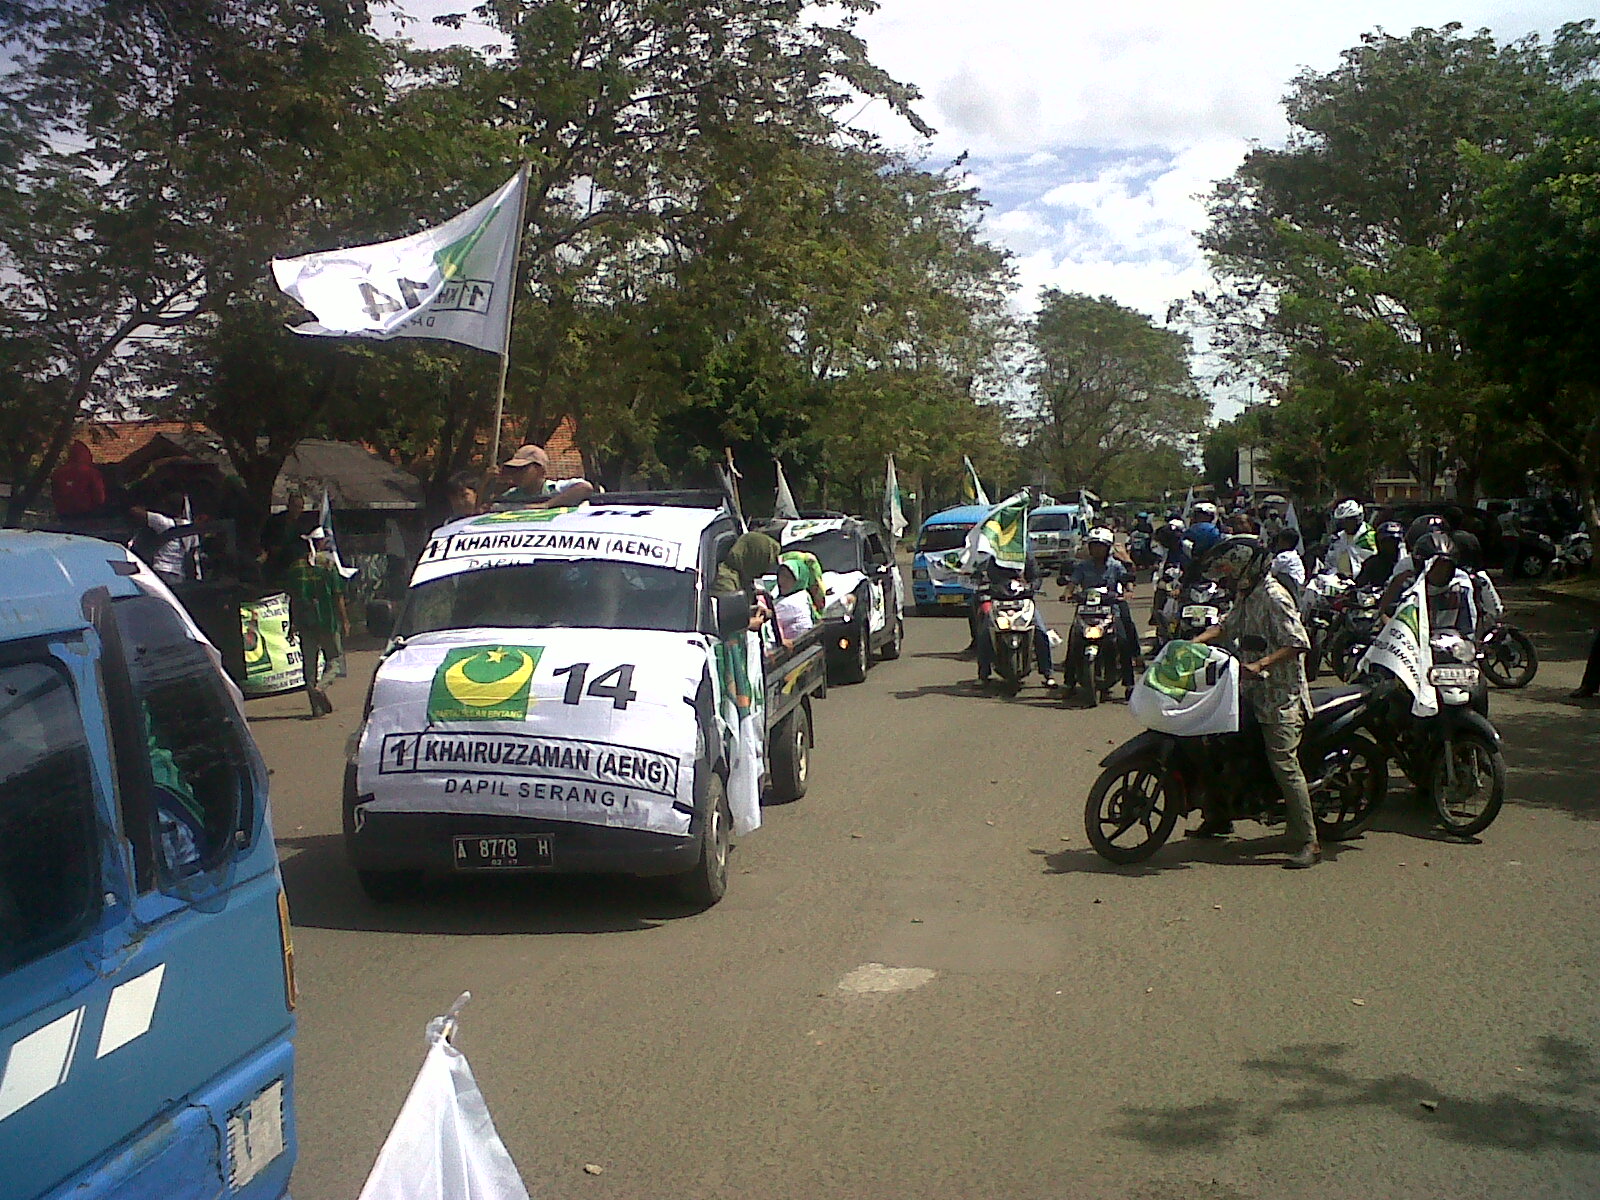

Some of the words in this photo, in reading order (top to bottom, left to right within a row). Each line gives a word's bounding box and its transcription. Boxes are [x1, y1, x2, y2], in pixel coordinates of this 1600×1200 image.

[454, 534, 600, 552] KHAIRUZZAMAN
[605, 537, 671, 563] (AENG)
[552, 663, 637, 710] 14
[425, 741, 590, 771] KHAIRUZZAMAN
[596, 751, 670, 790] (AENG)
[445, 779, 509, 797] DAPIL
[518, 783, 615, 807] SERANG
[458, 841, 467, 858] A
[480, 840, 517, 857] 8778
[538, 840, 549, 856] H
